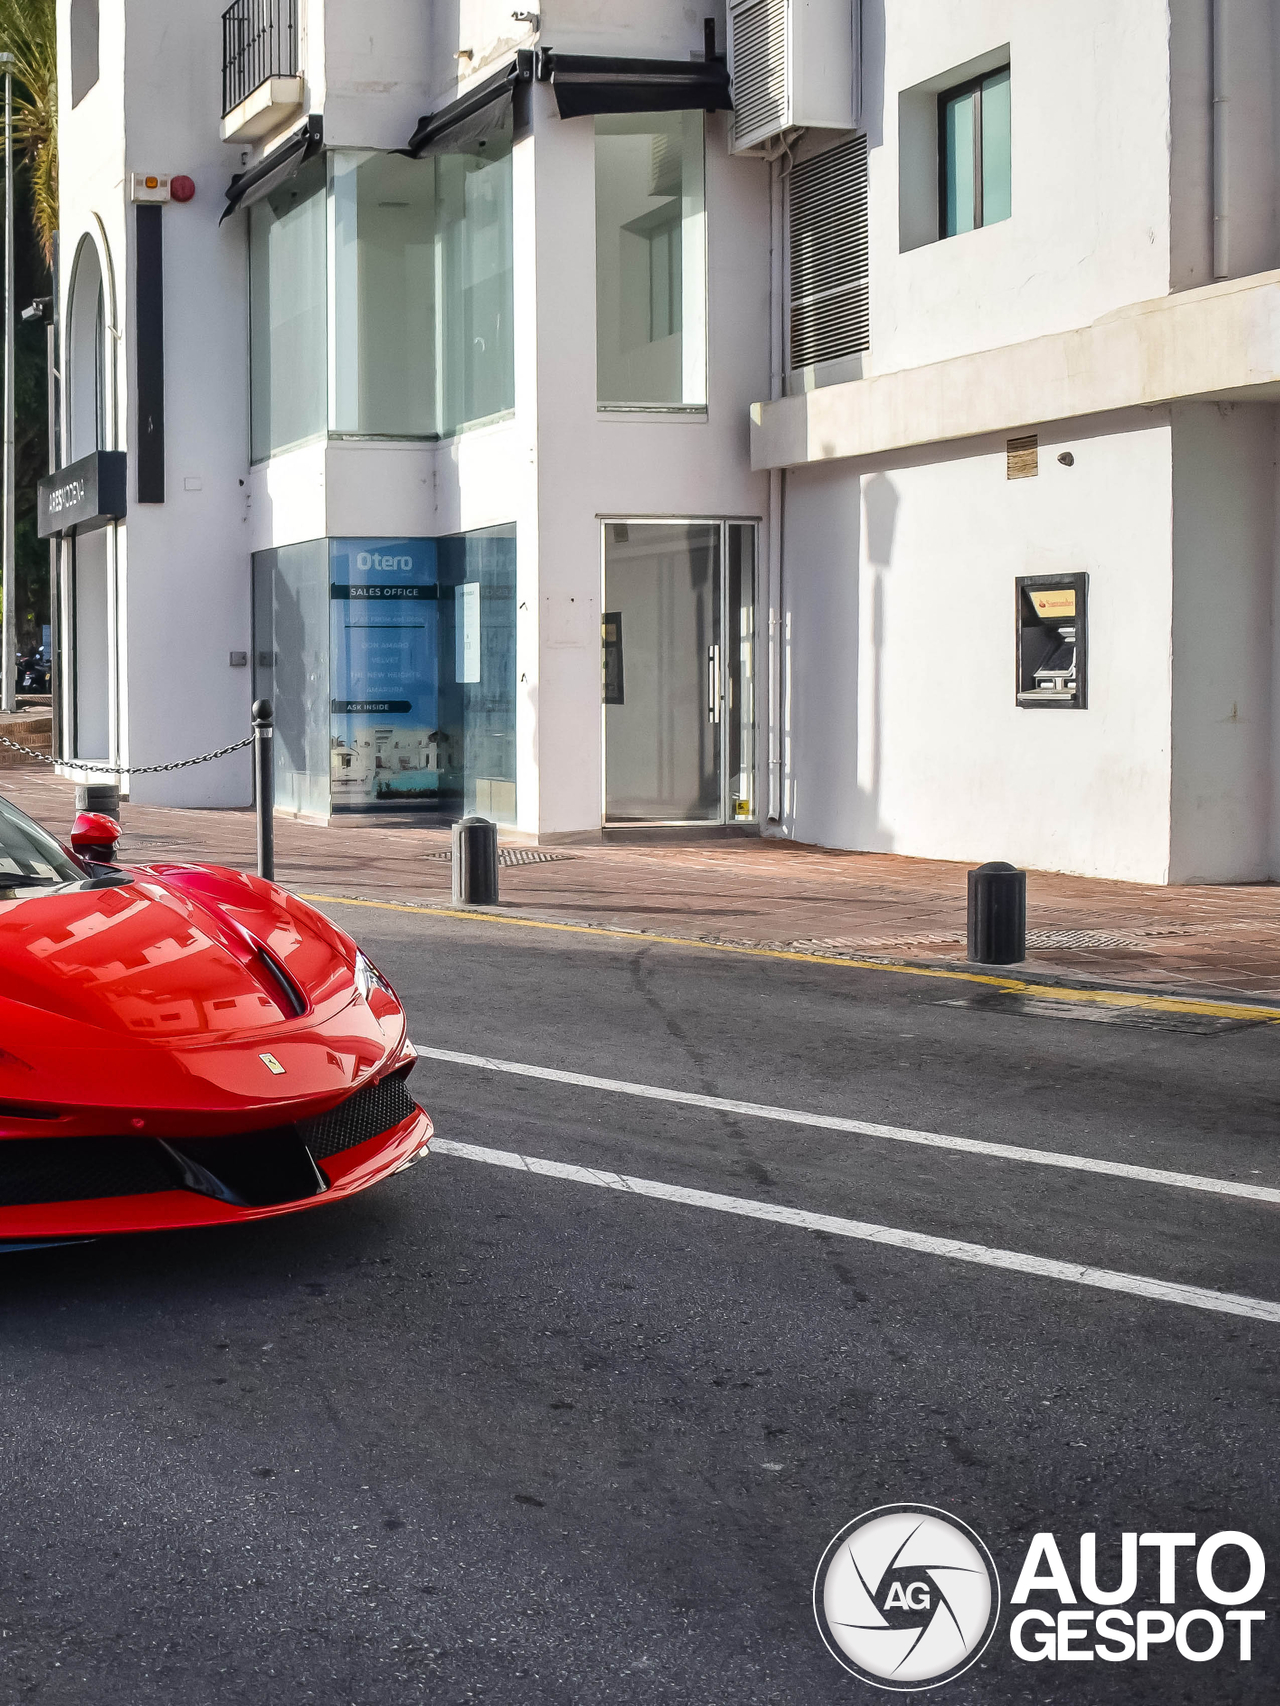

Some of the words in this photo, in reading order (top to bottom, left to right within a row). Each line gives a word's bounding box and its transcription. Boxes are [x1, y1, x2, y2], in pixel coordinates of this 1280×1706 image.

[356, 552, 413, 571] Otero
[350, 588, 381, 596] SALES
[384, 588, 419, 596] OFFICE
